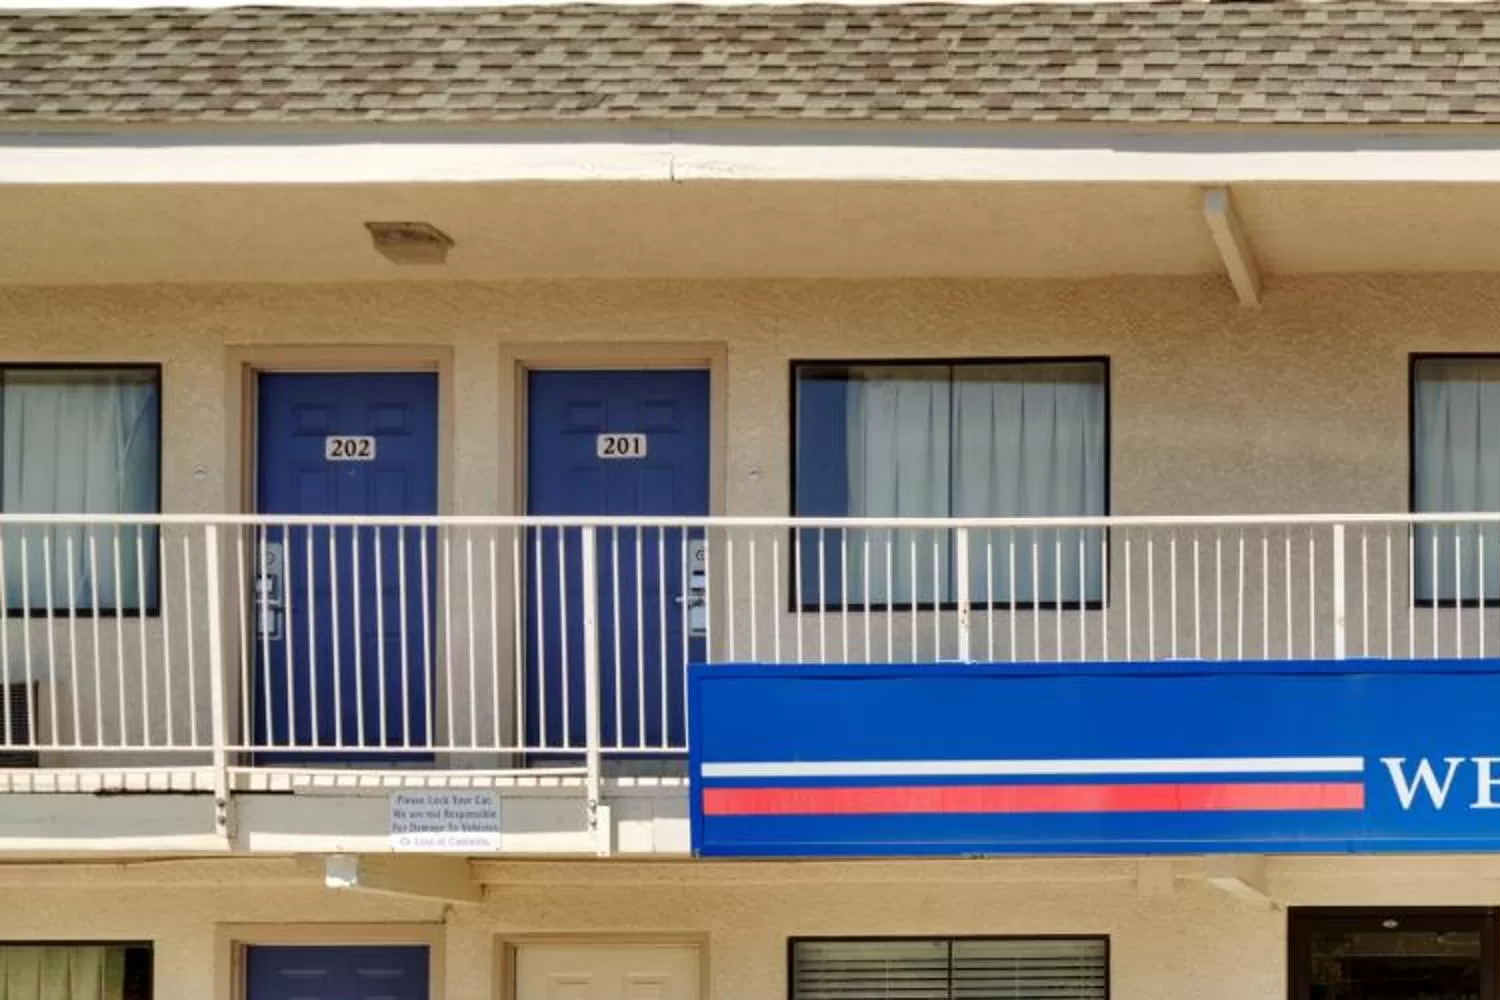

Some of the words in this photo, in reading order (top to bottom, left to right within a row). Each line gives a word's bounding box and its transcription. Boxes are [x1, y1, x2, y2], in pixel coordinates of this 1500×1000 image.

[331, 439, 370, 457] 202
[603, 437, 640, 455] 201
[397, 795, 425, 805] Please
[427, 795, 449, 805] Lock
[452, 795, 473, 805] Your
[393, 808, 406, 819] We
[409, 810, 424, 819] are
[426, 809, 440, 819] not
[443, 808, 497, 820] Responsible
[410, 822, 445, 834] Damage
